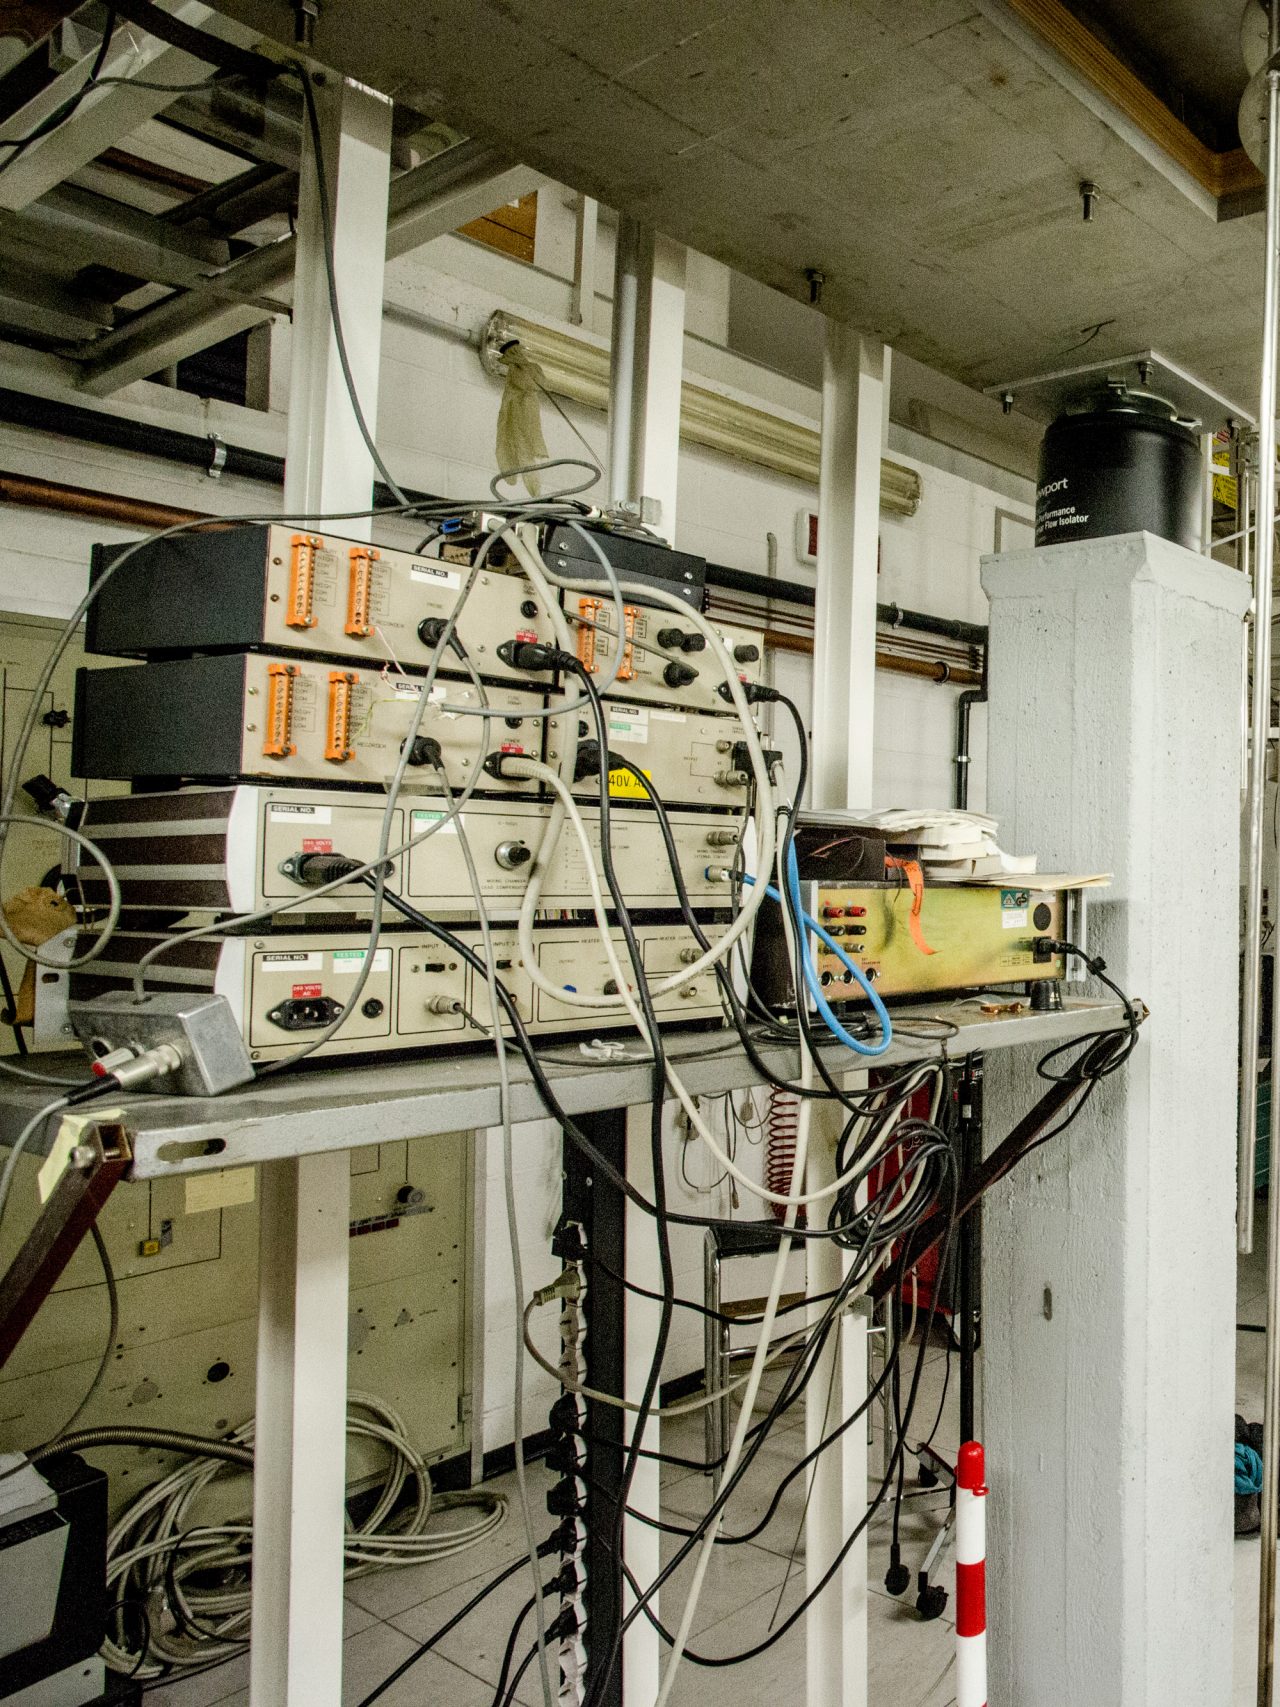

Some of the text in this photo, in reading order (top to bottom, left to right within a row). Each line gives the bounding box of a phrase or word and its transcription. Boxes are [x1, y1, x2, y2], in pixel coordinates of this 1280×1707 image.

[1059, 515, 1089, 526] Isolator
[413, 564, 435, 575] SERIAL
[608, 774, 632, 787] 40V.
[273, 804, 299, 812] SERIAL
